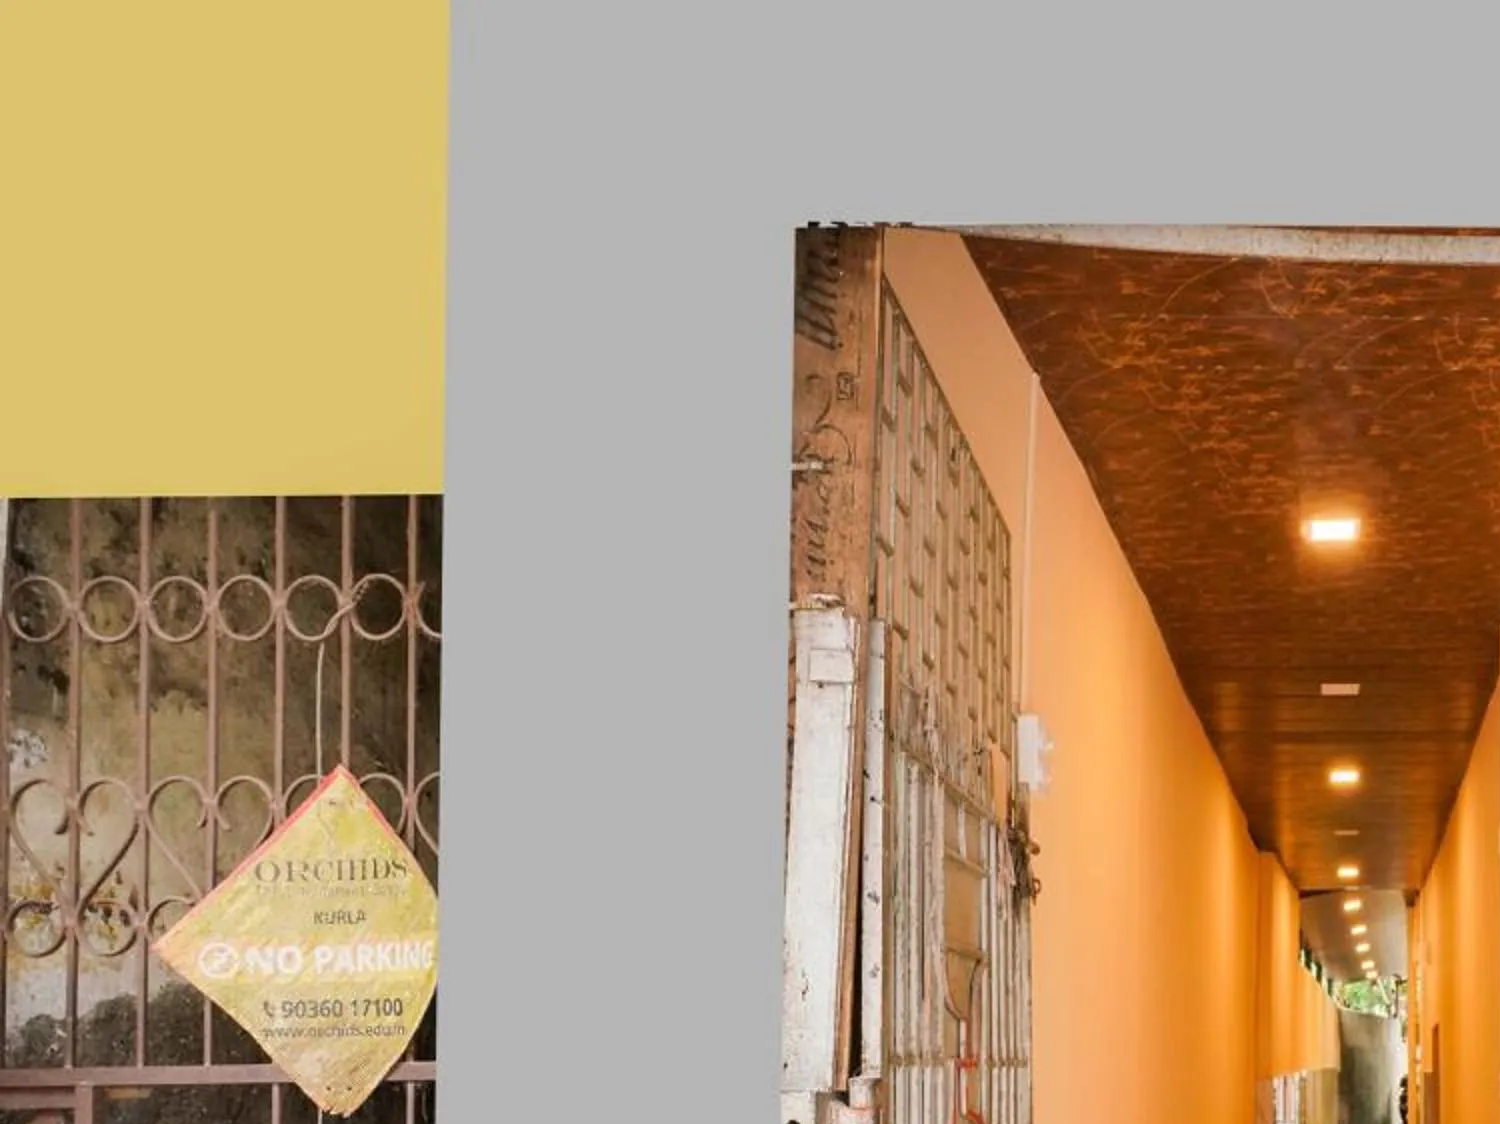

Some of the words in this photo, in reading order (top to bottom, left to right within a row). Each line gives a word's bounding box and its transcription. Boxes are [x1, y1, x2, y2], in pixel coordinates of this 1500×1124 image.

[254, 856, 408, 883] ORCHIDS
[313, 909, 367, 925] KURLA
[245, 944, 302, 975] NO
[313, 938, 434, 975] PARKING
[281, 999, 344, 1019] 90360
[351, 997, 404, 1017] 17100
